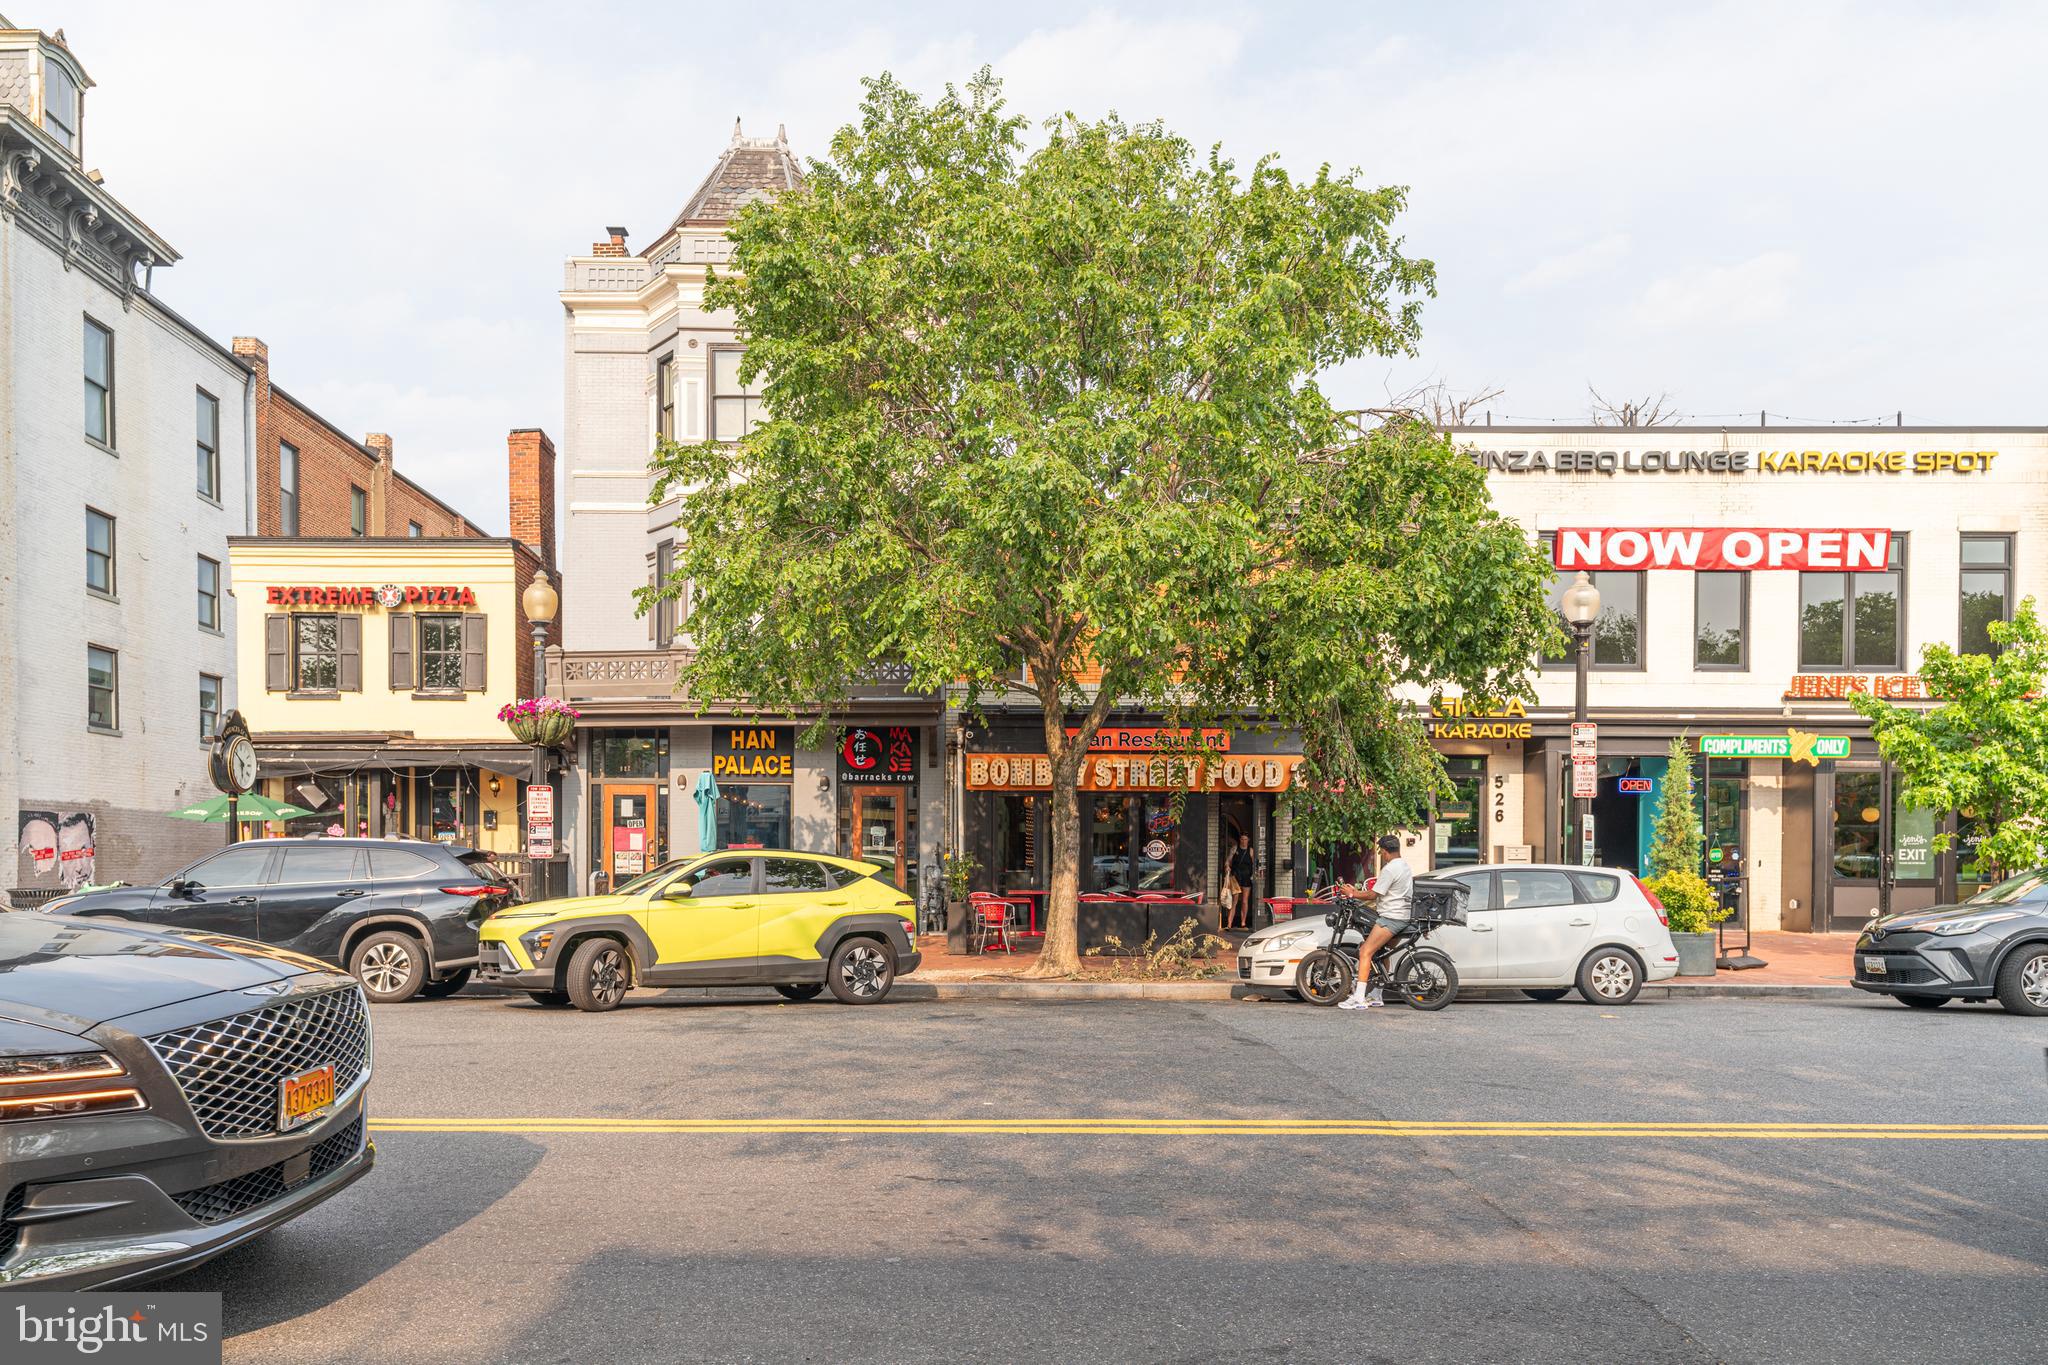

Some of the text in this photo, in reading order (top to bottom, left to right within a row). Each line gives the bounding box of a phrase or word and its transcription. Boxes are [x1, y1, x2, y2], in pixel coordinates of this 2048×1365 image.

[1555, 450, 1618, 475] BBQ
[1623, 450, 1749, 472] LOUNGE
[1757, 450, 1907, 472] KARAOKE
[1914, 450, 1998, 472] SPOT
[1561, 531, 1887, 566] NOW OPEN
[266, 586, 375, 605] EXTREME
[405, 586, 475, 605] PIZZA
[1785, 675, 1868, 698] JENI'S
[1874, 675, 1920, 698] ICE
[731, 729, 775, 749] HAN
[1435, 723, 1532, 738] KARAOKE
[1704, 739, 1846, 754] COMPLIMENTS ONLY
[714, 755, 792, 775] PALACE
[970, 758, 1088, 786] BOMBY
[1095, 759, 1200, 787] STREET
[1204, 760, 1284, 788] FOOD
[841, 773, 892, 781] @barracks
[1621, 780, 1651, 791] OPEN
[628, 820, 643, 828] OPEN
[1899, 849, 1927, 861] EXIT
[286, 1077, 332, 1115] A379331
